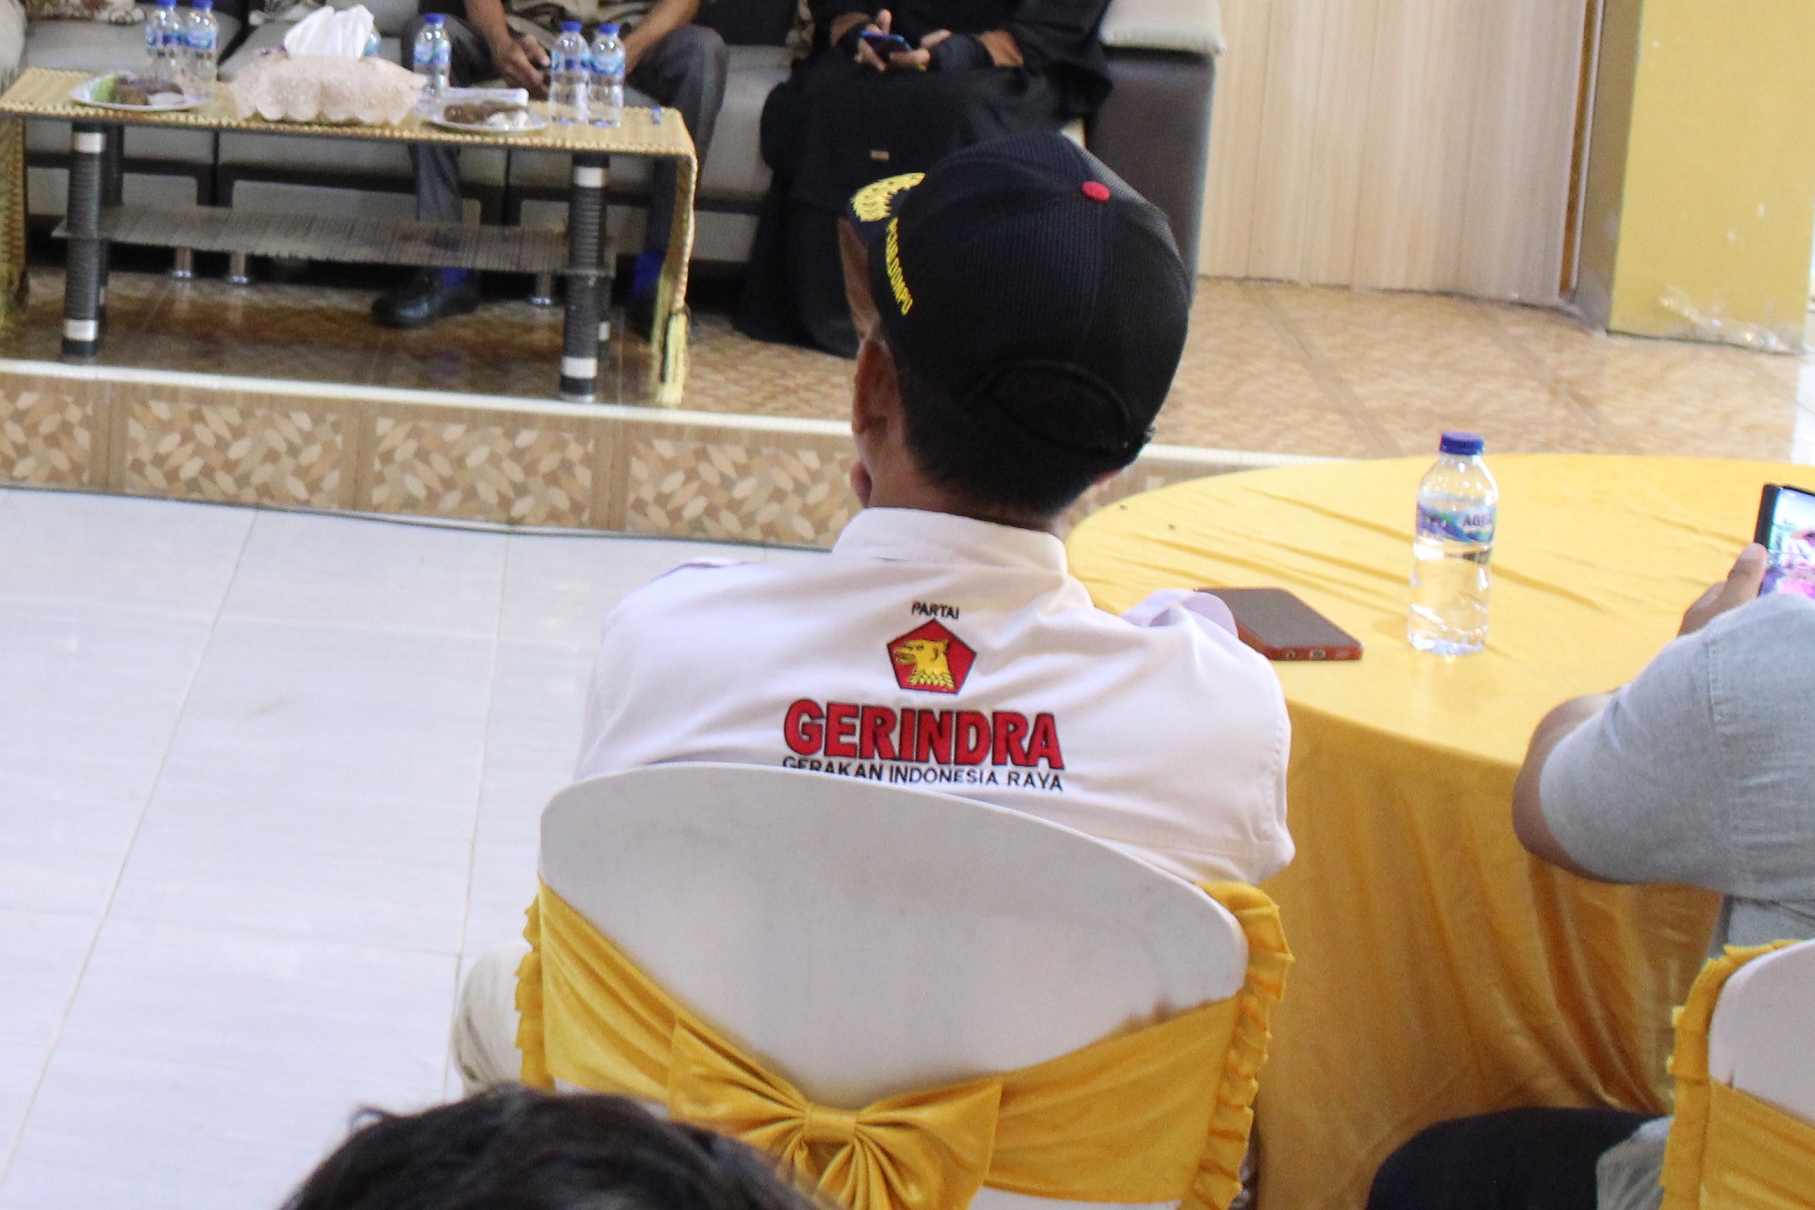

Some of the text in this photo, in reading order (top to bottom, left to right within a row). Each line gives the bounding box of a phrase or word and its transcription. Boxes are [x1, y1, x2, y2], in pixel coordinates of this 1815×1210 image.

[911, 601, 959, 620] PARTAI
[783, 699, 1065, 770] GERINDRA
[782, 756, 1064, 791] GERAKAN INDONESIA RAYA
